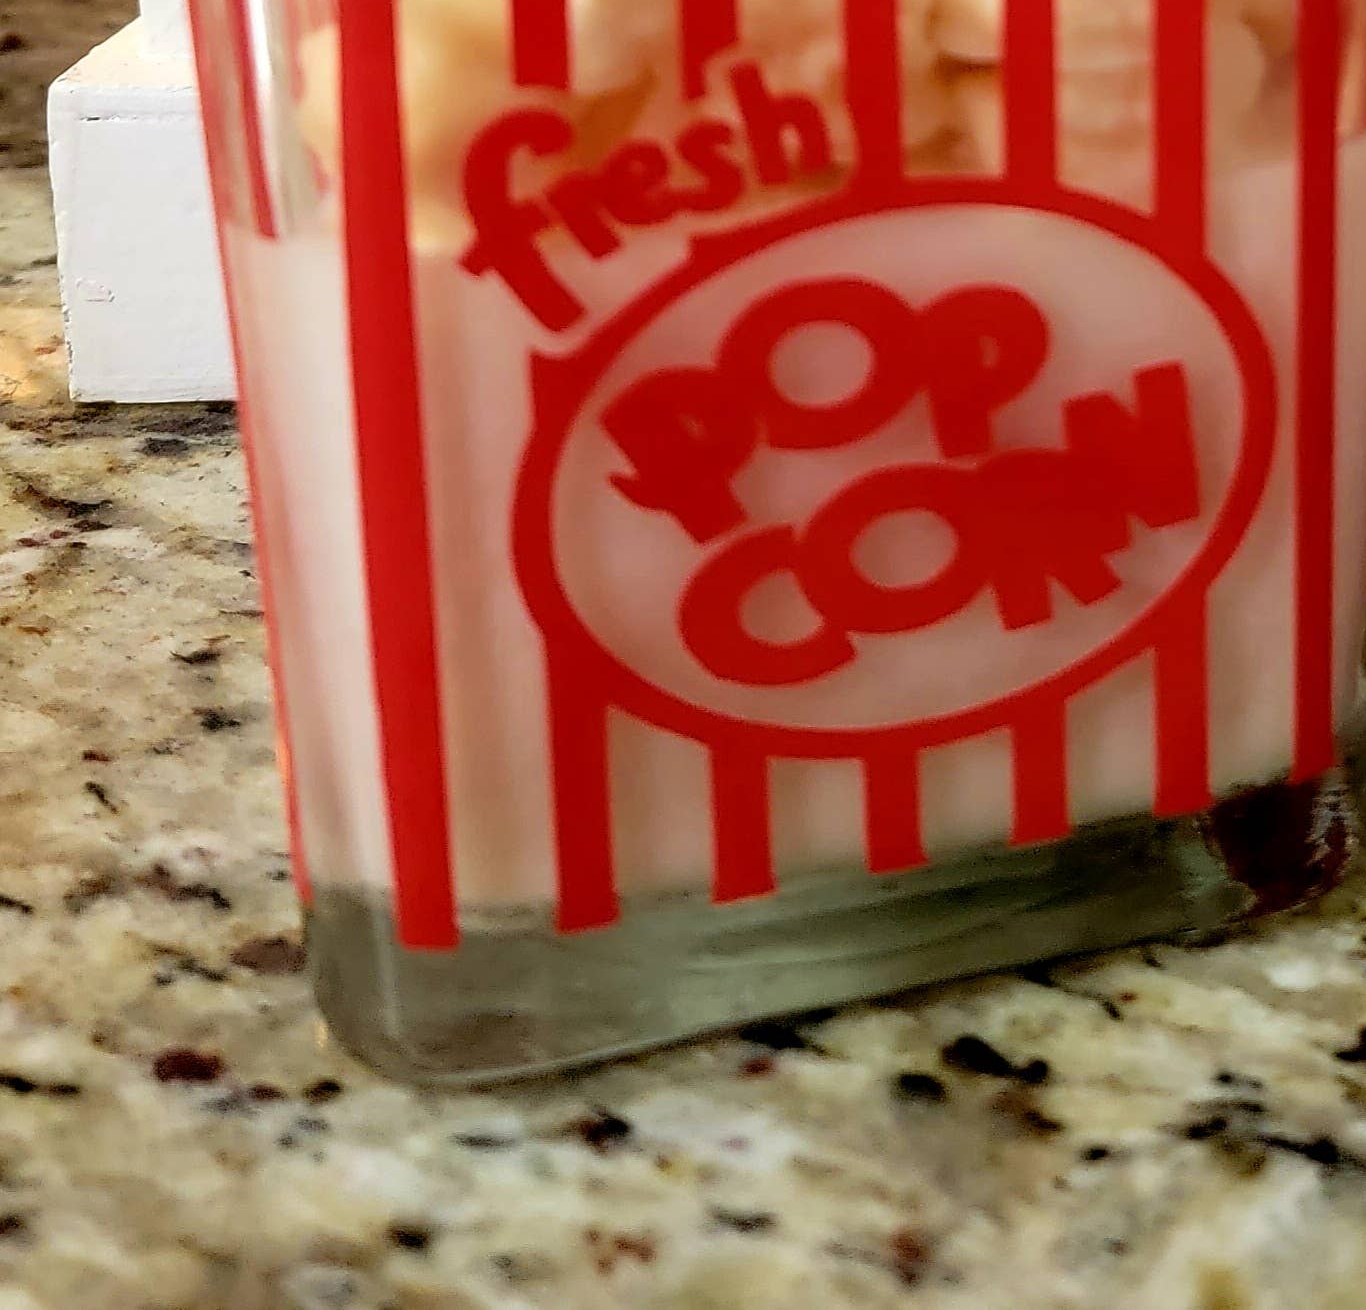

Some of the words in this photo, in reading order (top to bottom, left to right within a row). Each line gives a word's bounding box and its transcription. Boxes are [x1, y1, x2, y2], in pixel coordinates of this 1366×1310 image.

[459, 58, 833, 333] fresh
[599, 275, 1050, 546] POP
[677, 359, 1201, 687] CORN
